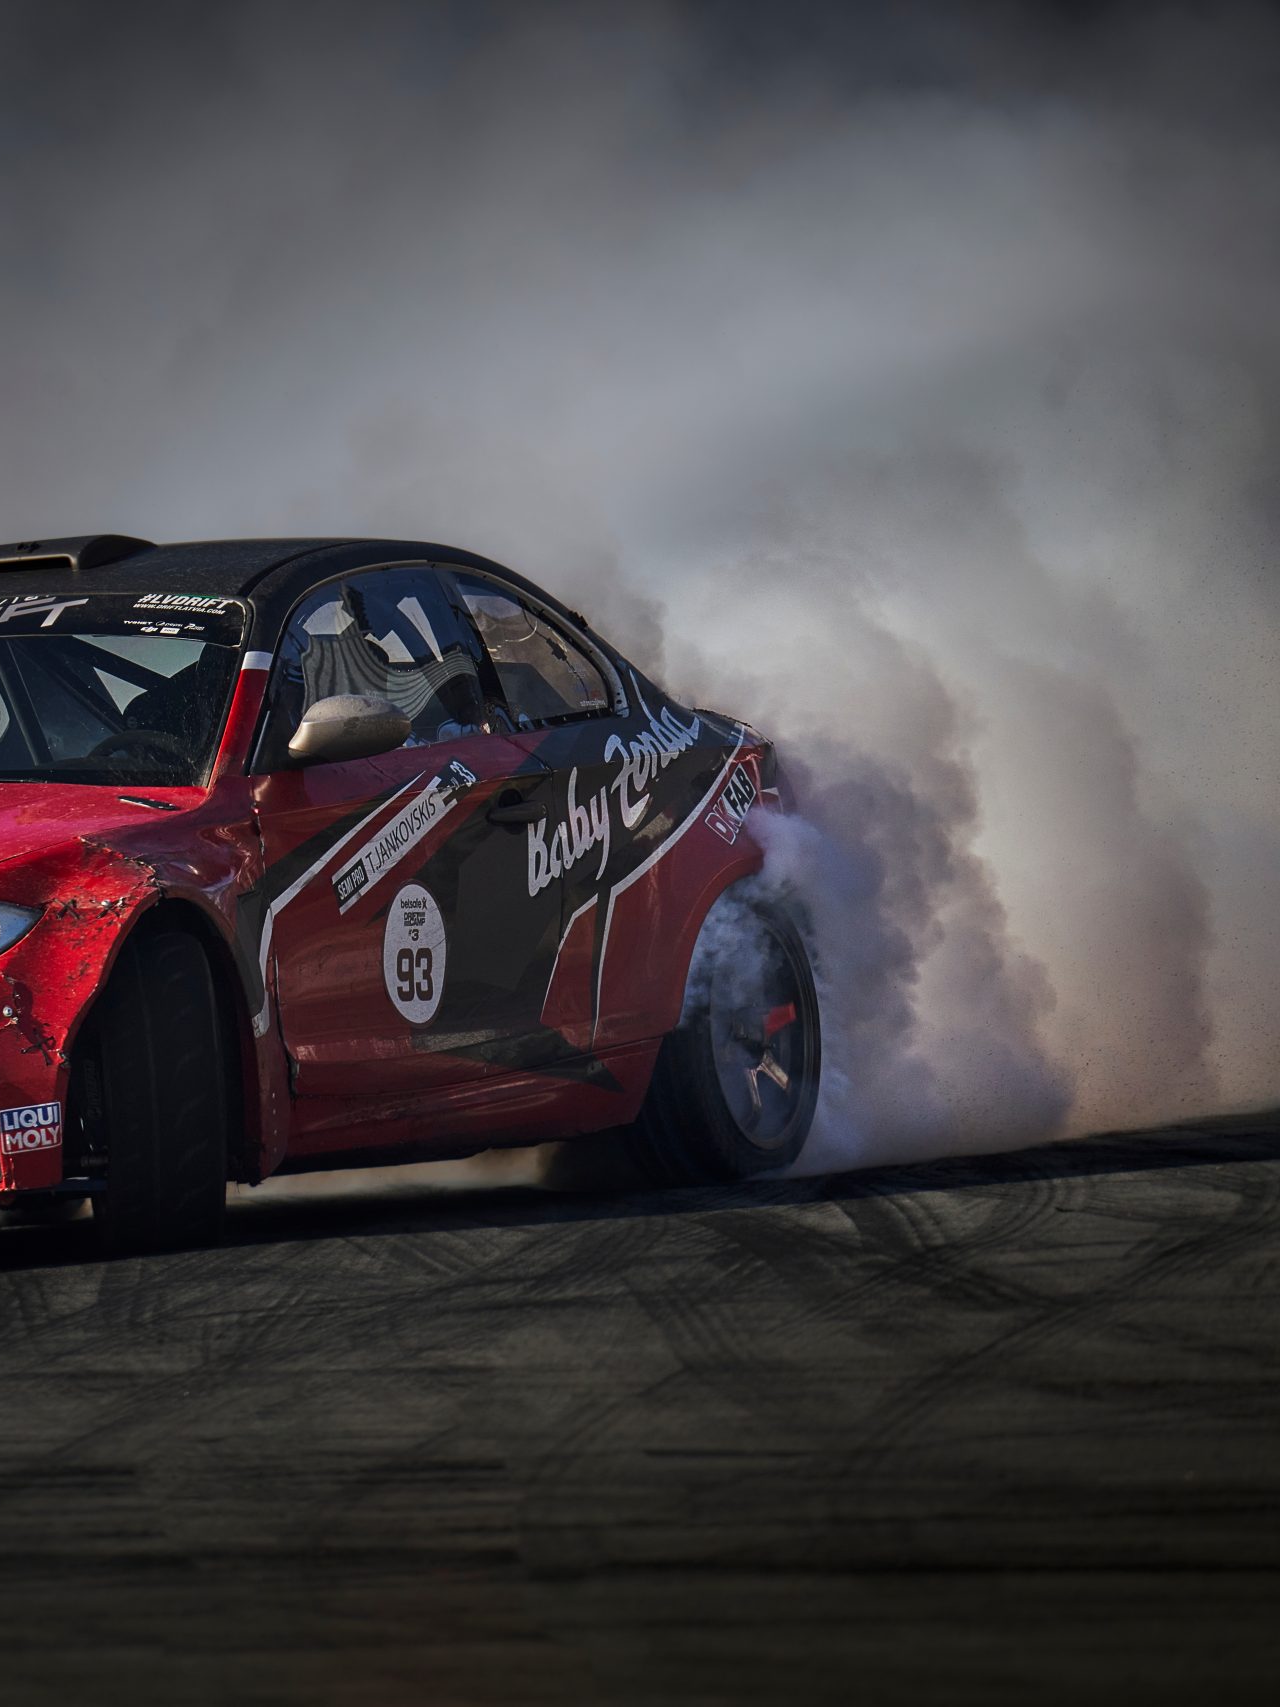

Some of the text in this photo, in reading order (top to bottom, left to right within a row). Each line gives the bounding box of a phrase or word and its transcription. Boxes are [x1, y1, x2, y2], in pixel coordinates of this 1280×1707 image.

[132, 603, 226, 615] WWW.DRIFTLATVIA.COM
[137, 593, 234, 609] #LVDRIFT
[365, 794, 437, 873] T.JANKOVSKIS
[527, 767, 610, 897] Baby
[337, 865, 365, 900] SEMI PRO
[396, 947, 434, 1002] 93
[2, 1105, 58, 1131] LIQUI
[5, 1125, 60, 1151] MOLY
